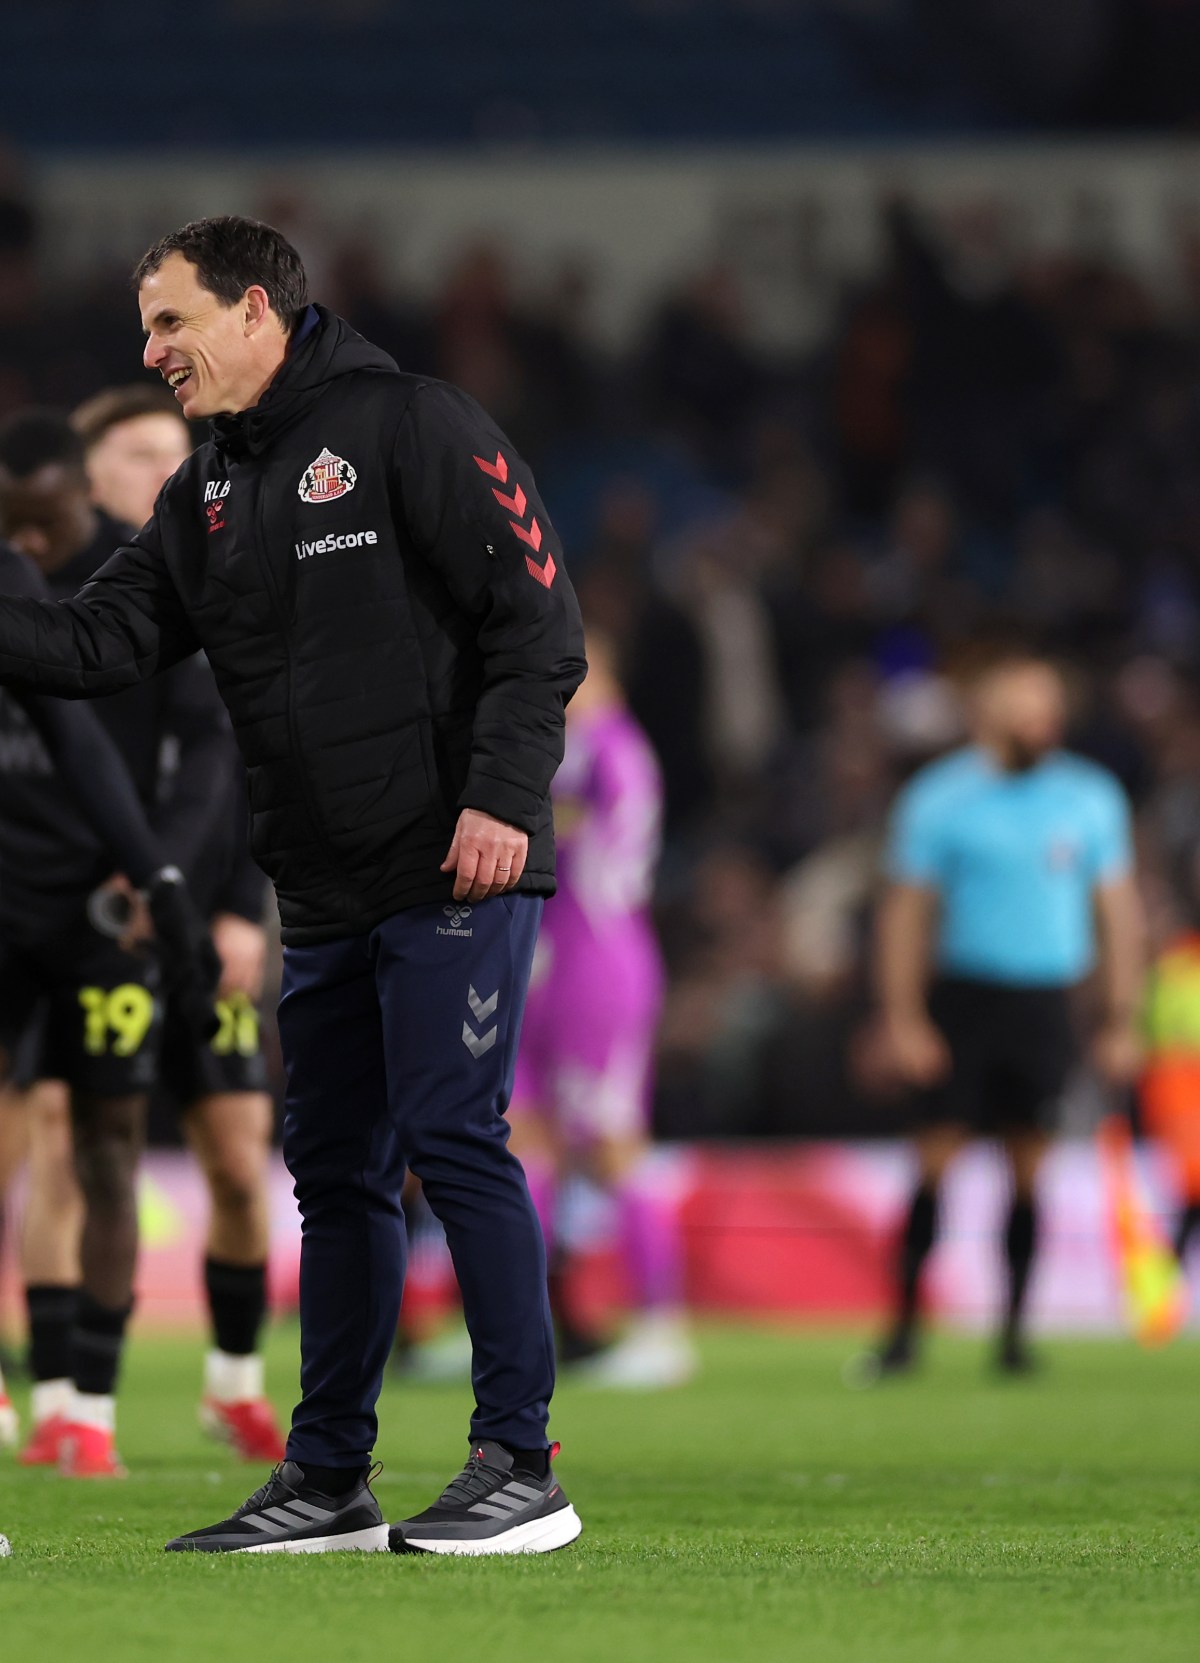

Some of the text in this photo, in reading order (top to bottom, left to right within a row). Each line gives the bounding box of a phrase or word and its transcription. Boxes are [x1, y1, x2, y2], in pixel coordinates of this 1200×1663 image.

[204, 480, 231, 503] RLB
[295, 530, 378, 560] LiveScore
[436, 926, 473, 937] hummel
[79, 983, 154, 1056] 19
